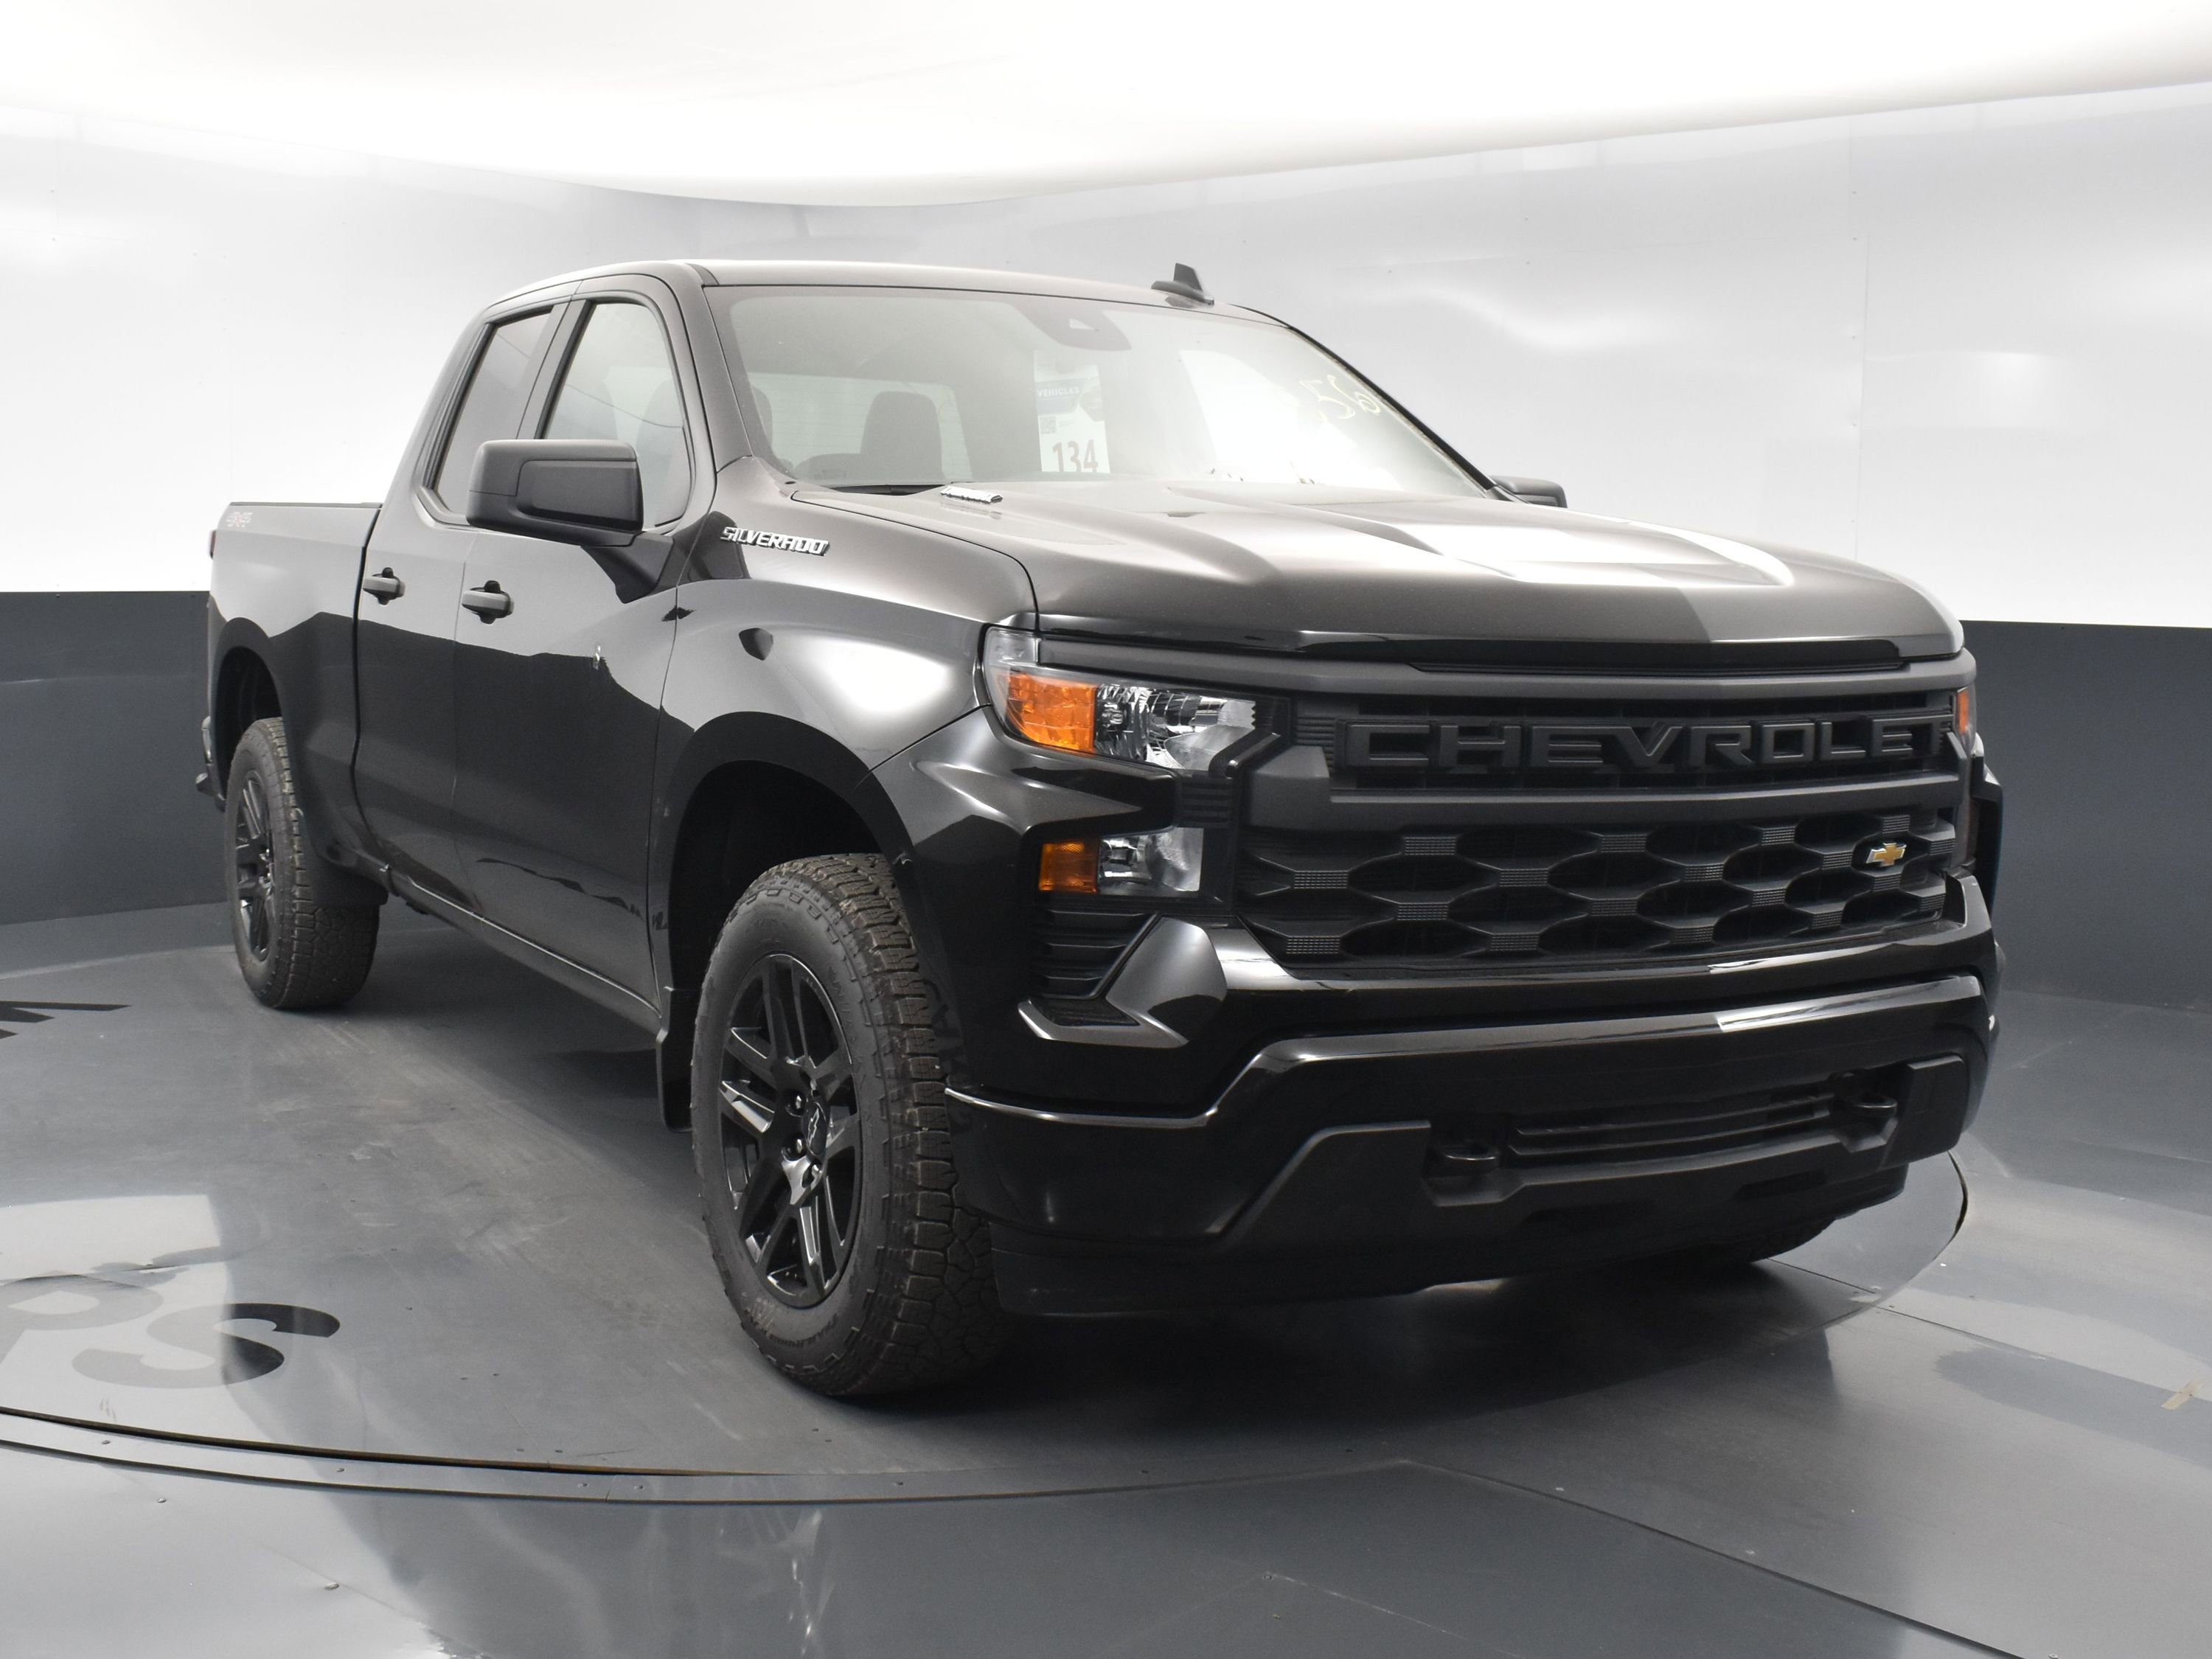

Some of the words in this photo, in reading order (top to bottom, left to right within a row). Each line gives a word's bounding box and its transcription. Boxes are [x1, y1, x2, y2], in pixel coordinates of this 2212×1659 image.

[1037, 386, 1080, 397] VEHICLES
[1052, 439, 1099, 473] 134
[720, 526, 830, 557] SILVERADO
[1335, 712, 1955, 772] CHEVROLET
